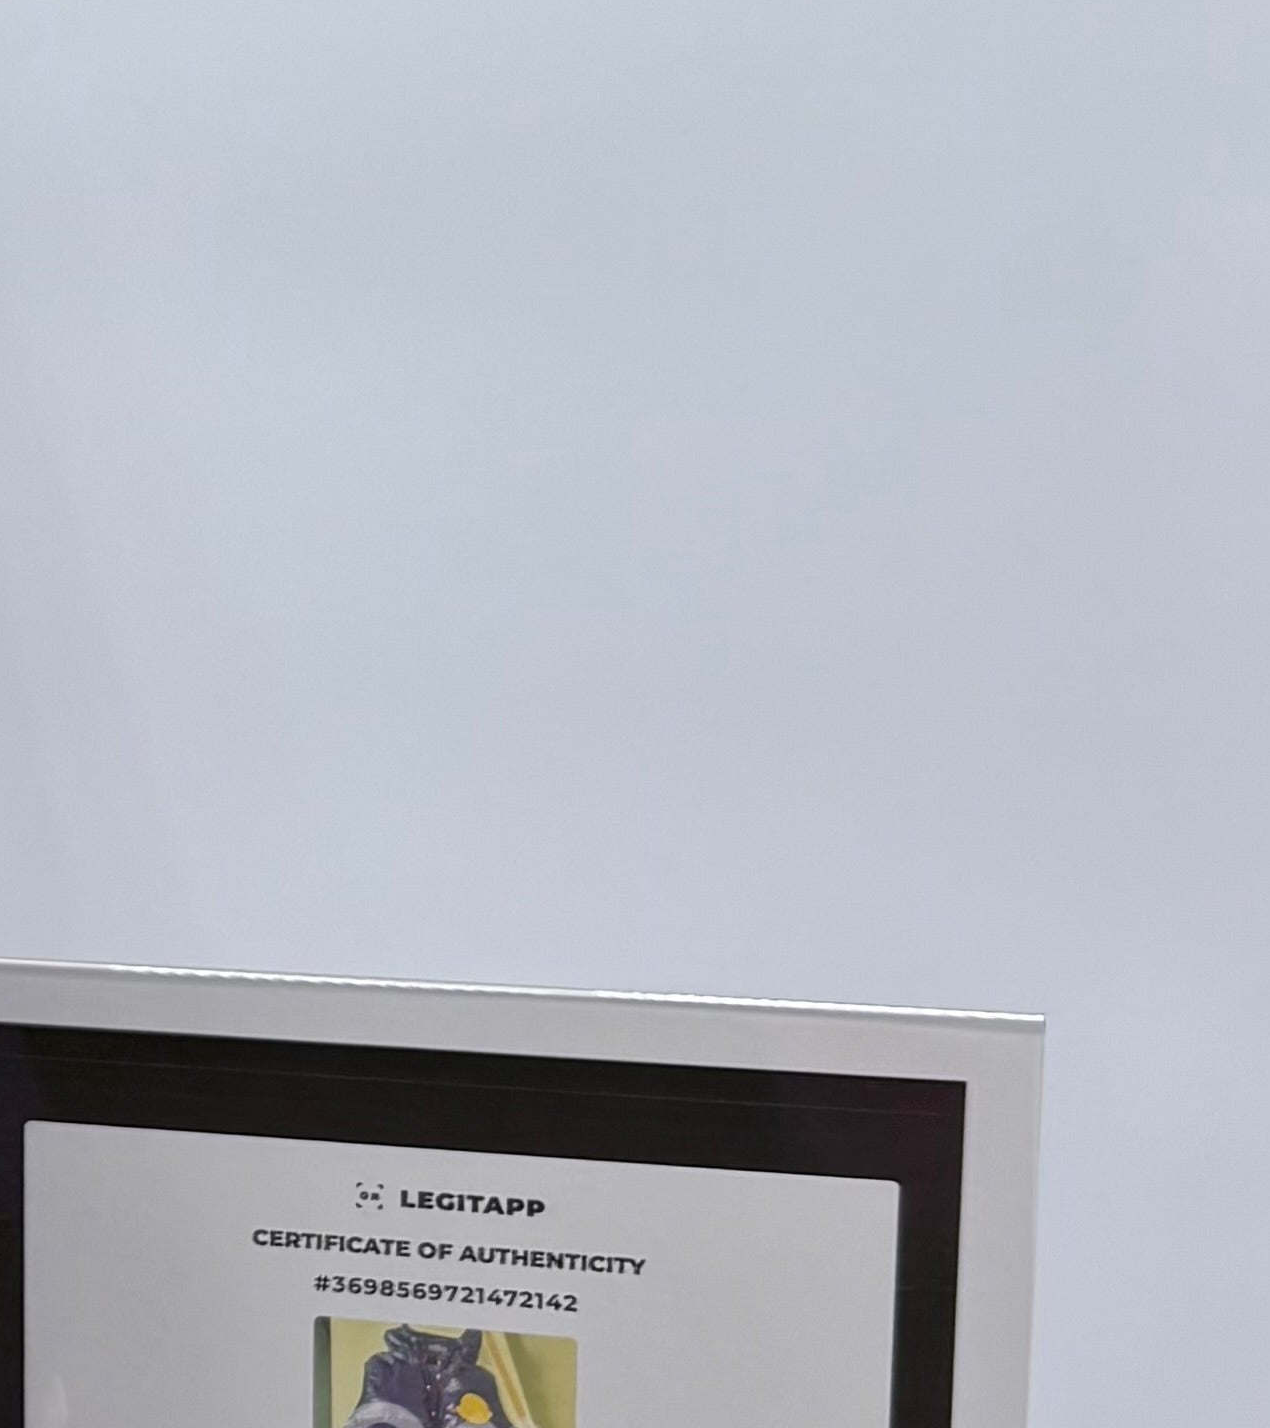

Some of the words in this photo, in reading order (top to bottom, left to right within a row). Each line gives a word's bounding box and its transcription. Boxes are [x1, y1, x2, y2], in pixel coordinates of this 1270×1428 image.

[399, 1189, 547, 1217] LEGITAPP
[252, 1228, 411, 1258] CERTIFICATE
[417, 1242, 453, 1261] OF
[459, 1245, 647, 1276] AUTHENTICITY
[313, 1275, 580, 1313] #3698569721472142
